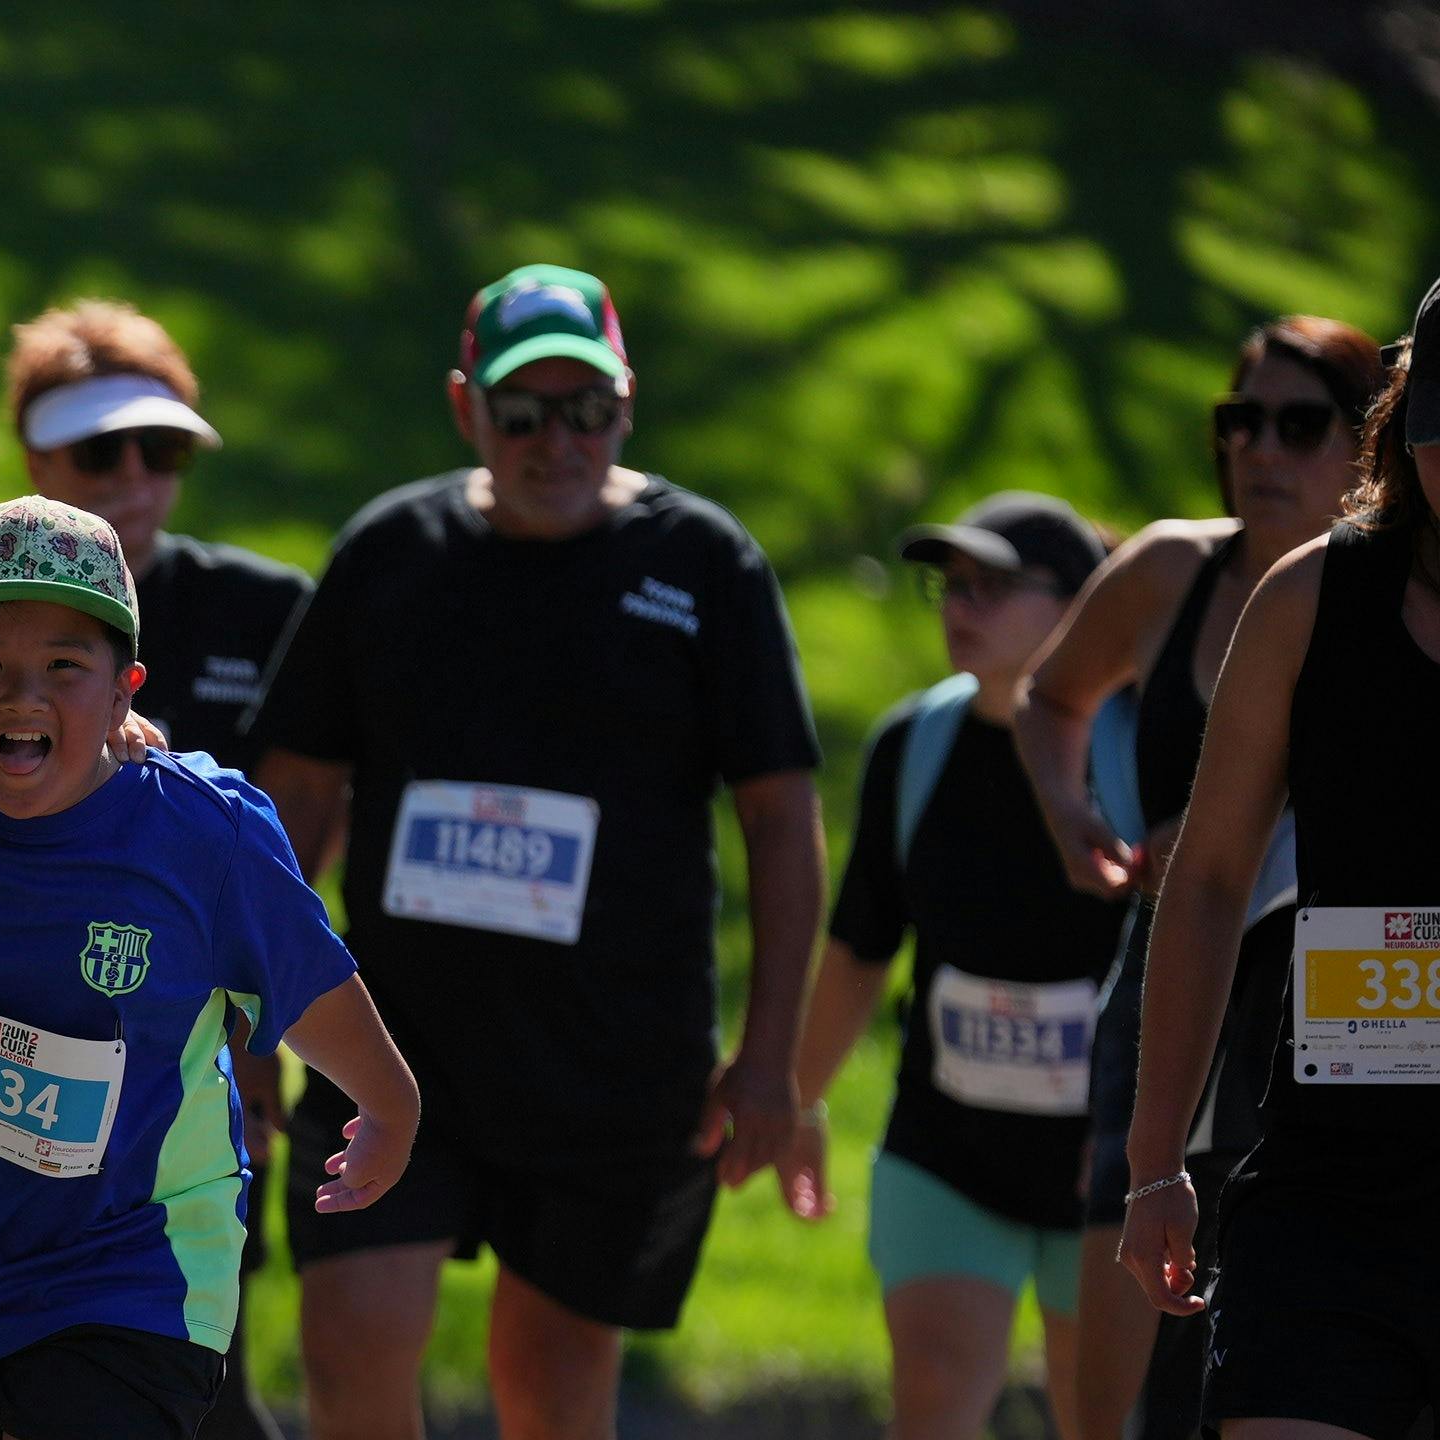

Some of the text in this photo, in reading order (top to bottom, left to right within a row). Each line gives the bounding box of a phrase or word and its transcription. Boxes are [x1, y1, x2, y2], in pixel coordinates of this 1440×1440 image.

[435, 822, 553, 877] 11489
[1361, 1019, 1407, 1029] GHELLA
[0, 1036, 38, 1060] CURE
